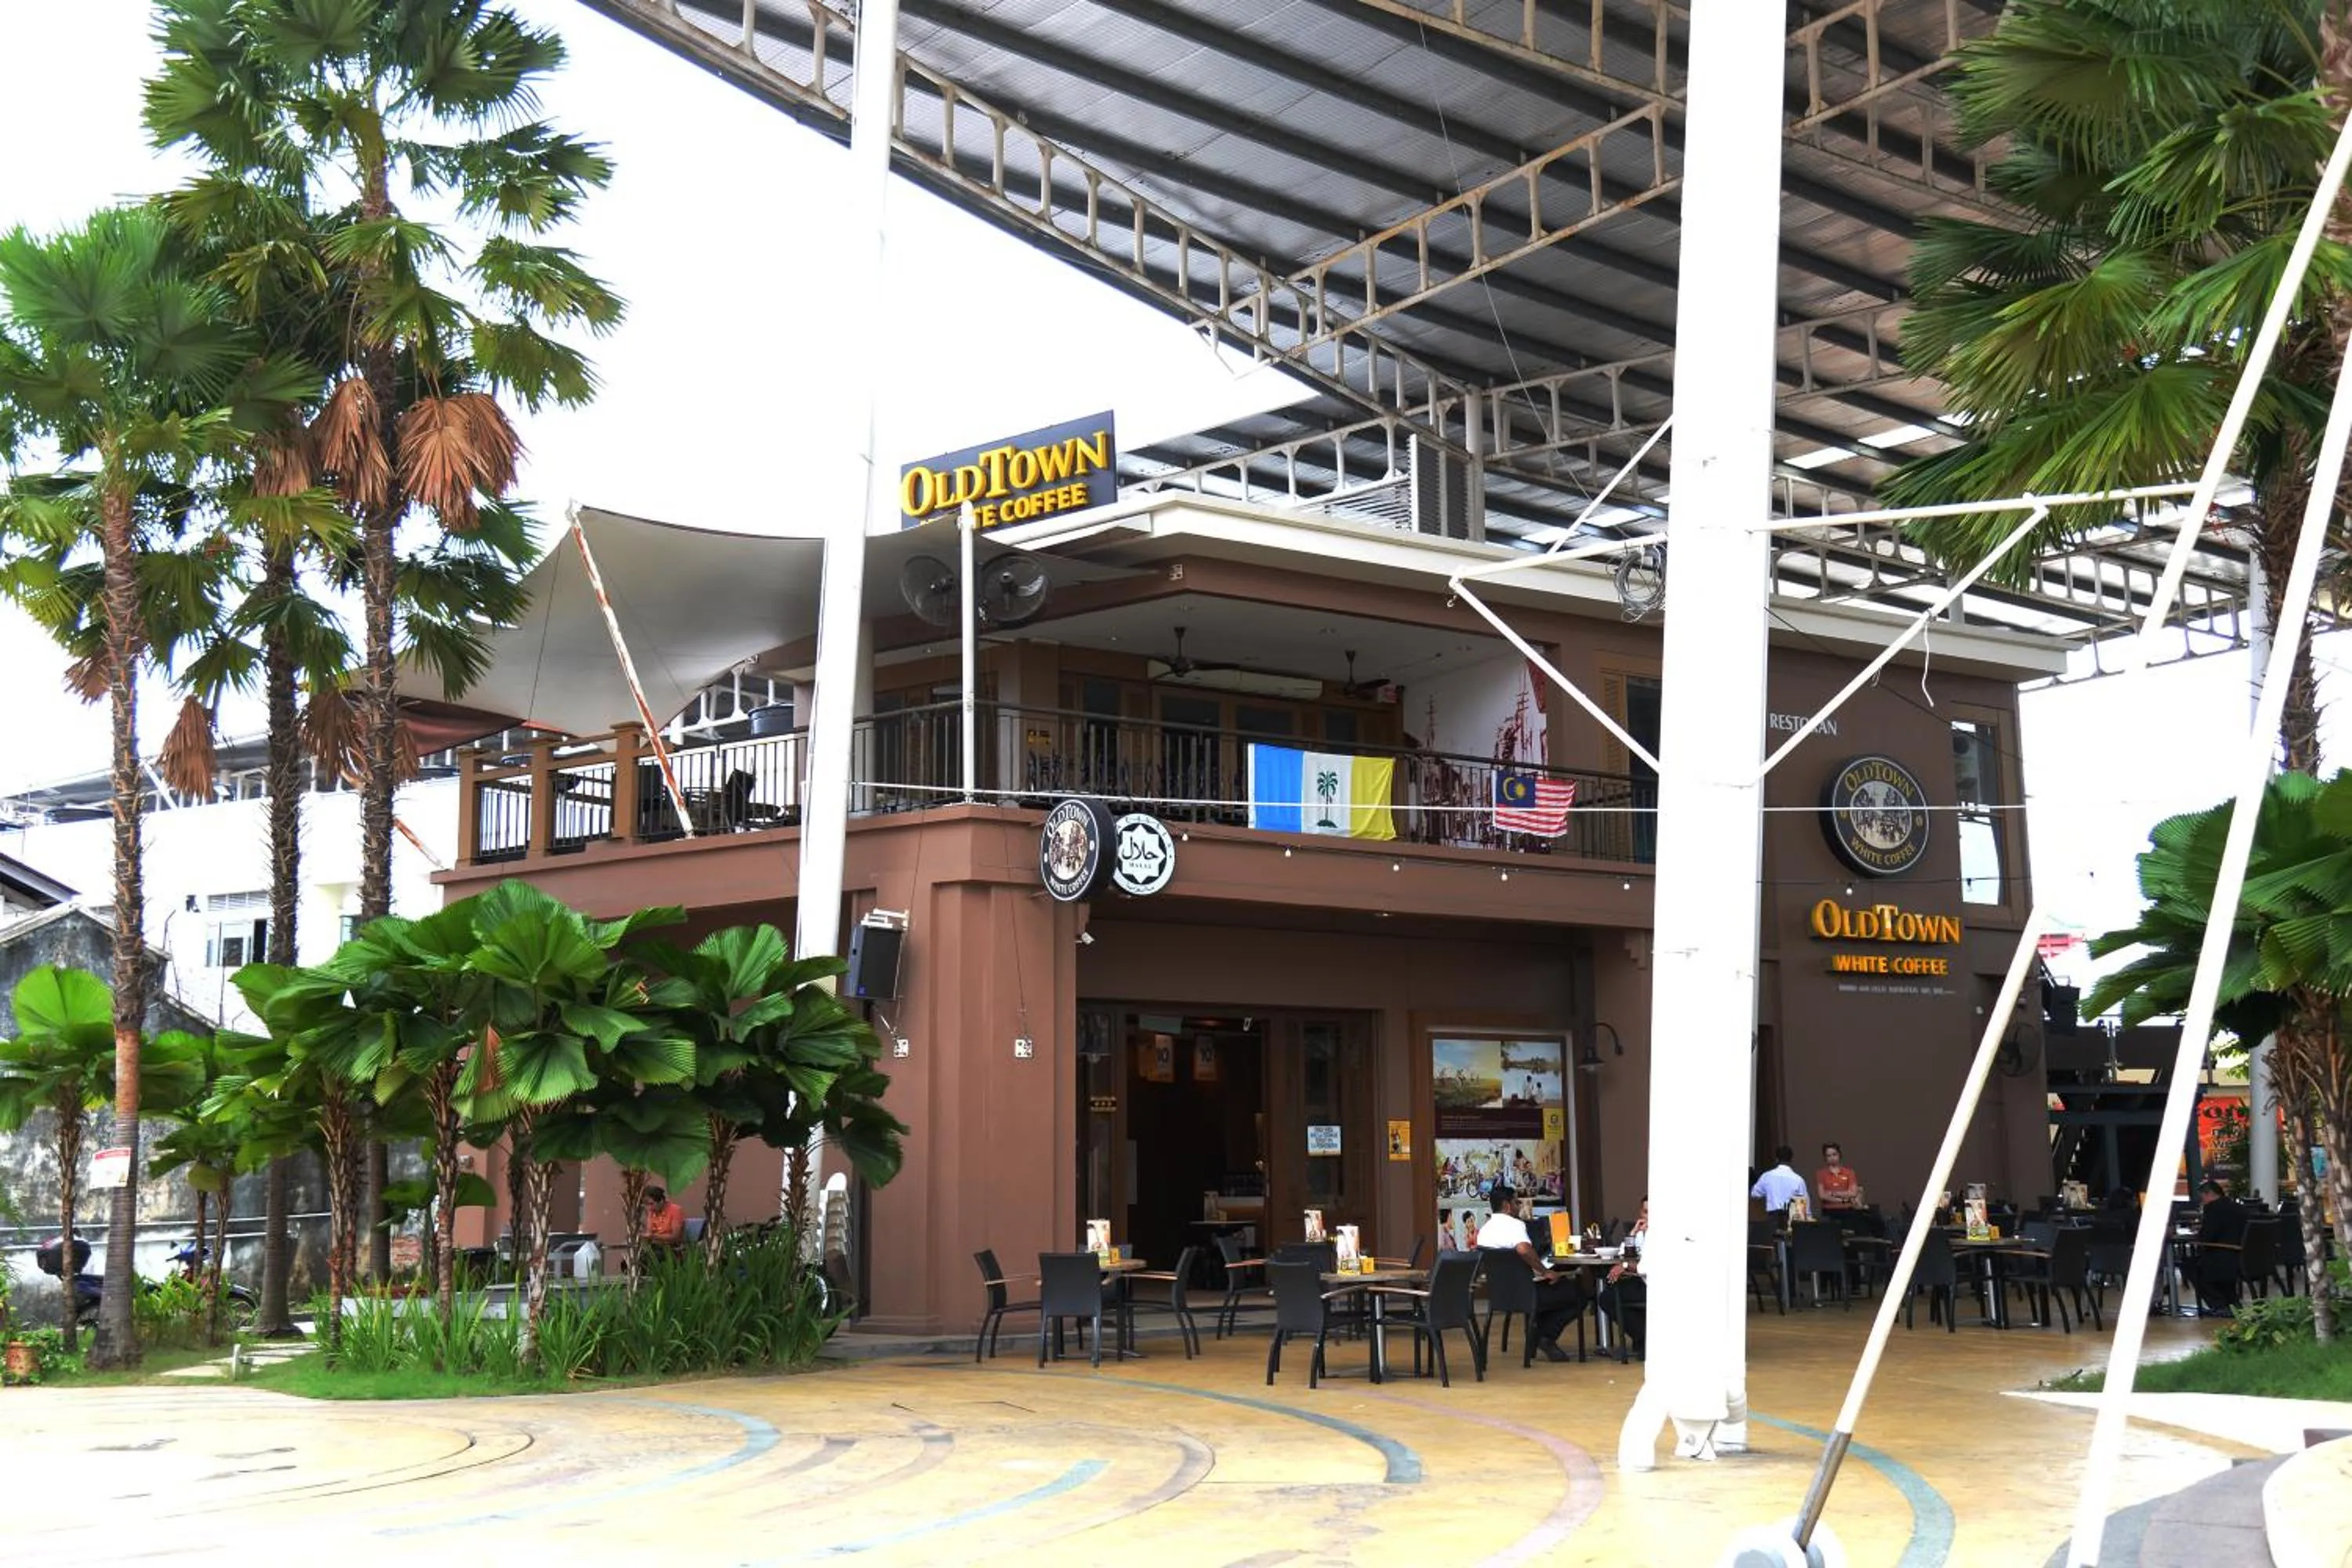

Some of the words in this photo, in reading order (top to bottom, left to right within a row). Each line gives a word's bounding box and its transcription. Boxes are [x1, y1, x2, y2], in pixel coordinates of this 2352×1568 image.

[901, 430, 1107, 517] OLDTOWN
[1000, 483, 1087, 521] COFFEE
[1769, 713, 1838, 737] RESTOAN
[1845, 760, 1915, 799] OLDTOWN
[1851, 836, 1883, 865] WHITE
[1884, 843, 1916, 866] COFFEE
[1812, 899, 1962, 944] OLDTOWN
[1832, 954, 1889, 974] WHITE
[1893, 956, 1949, 976] COFFEE
